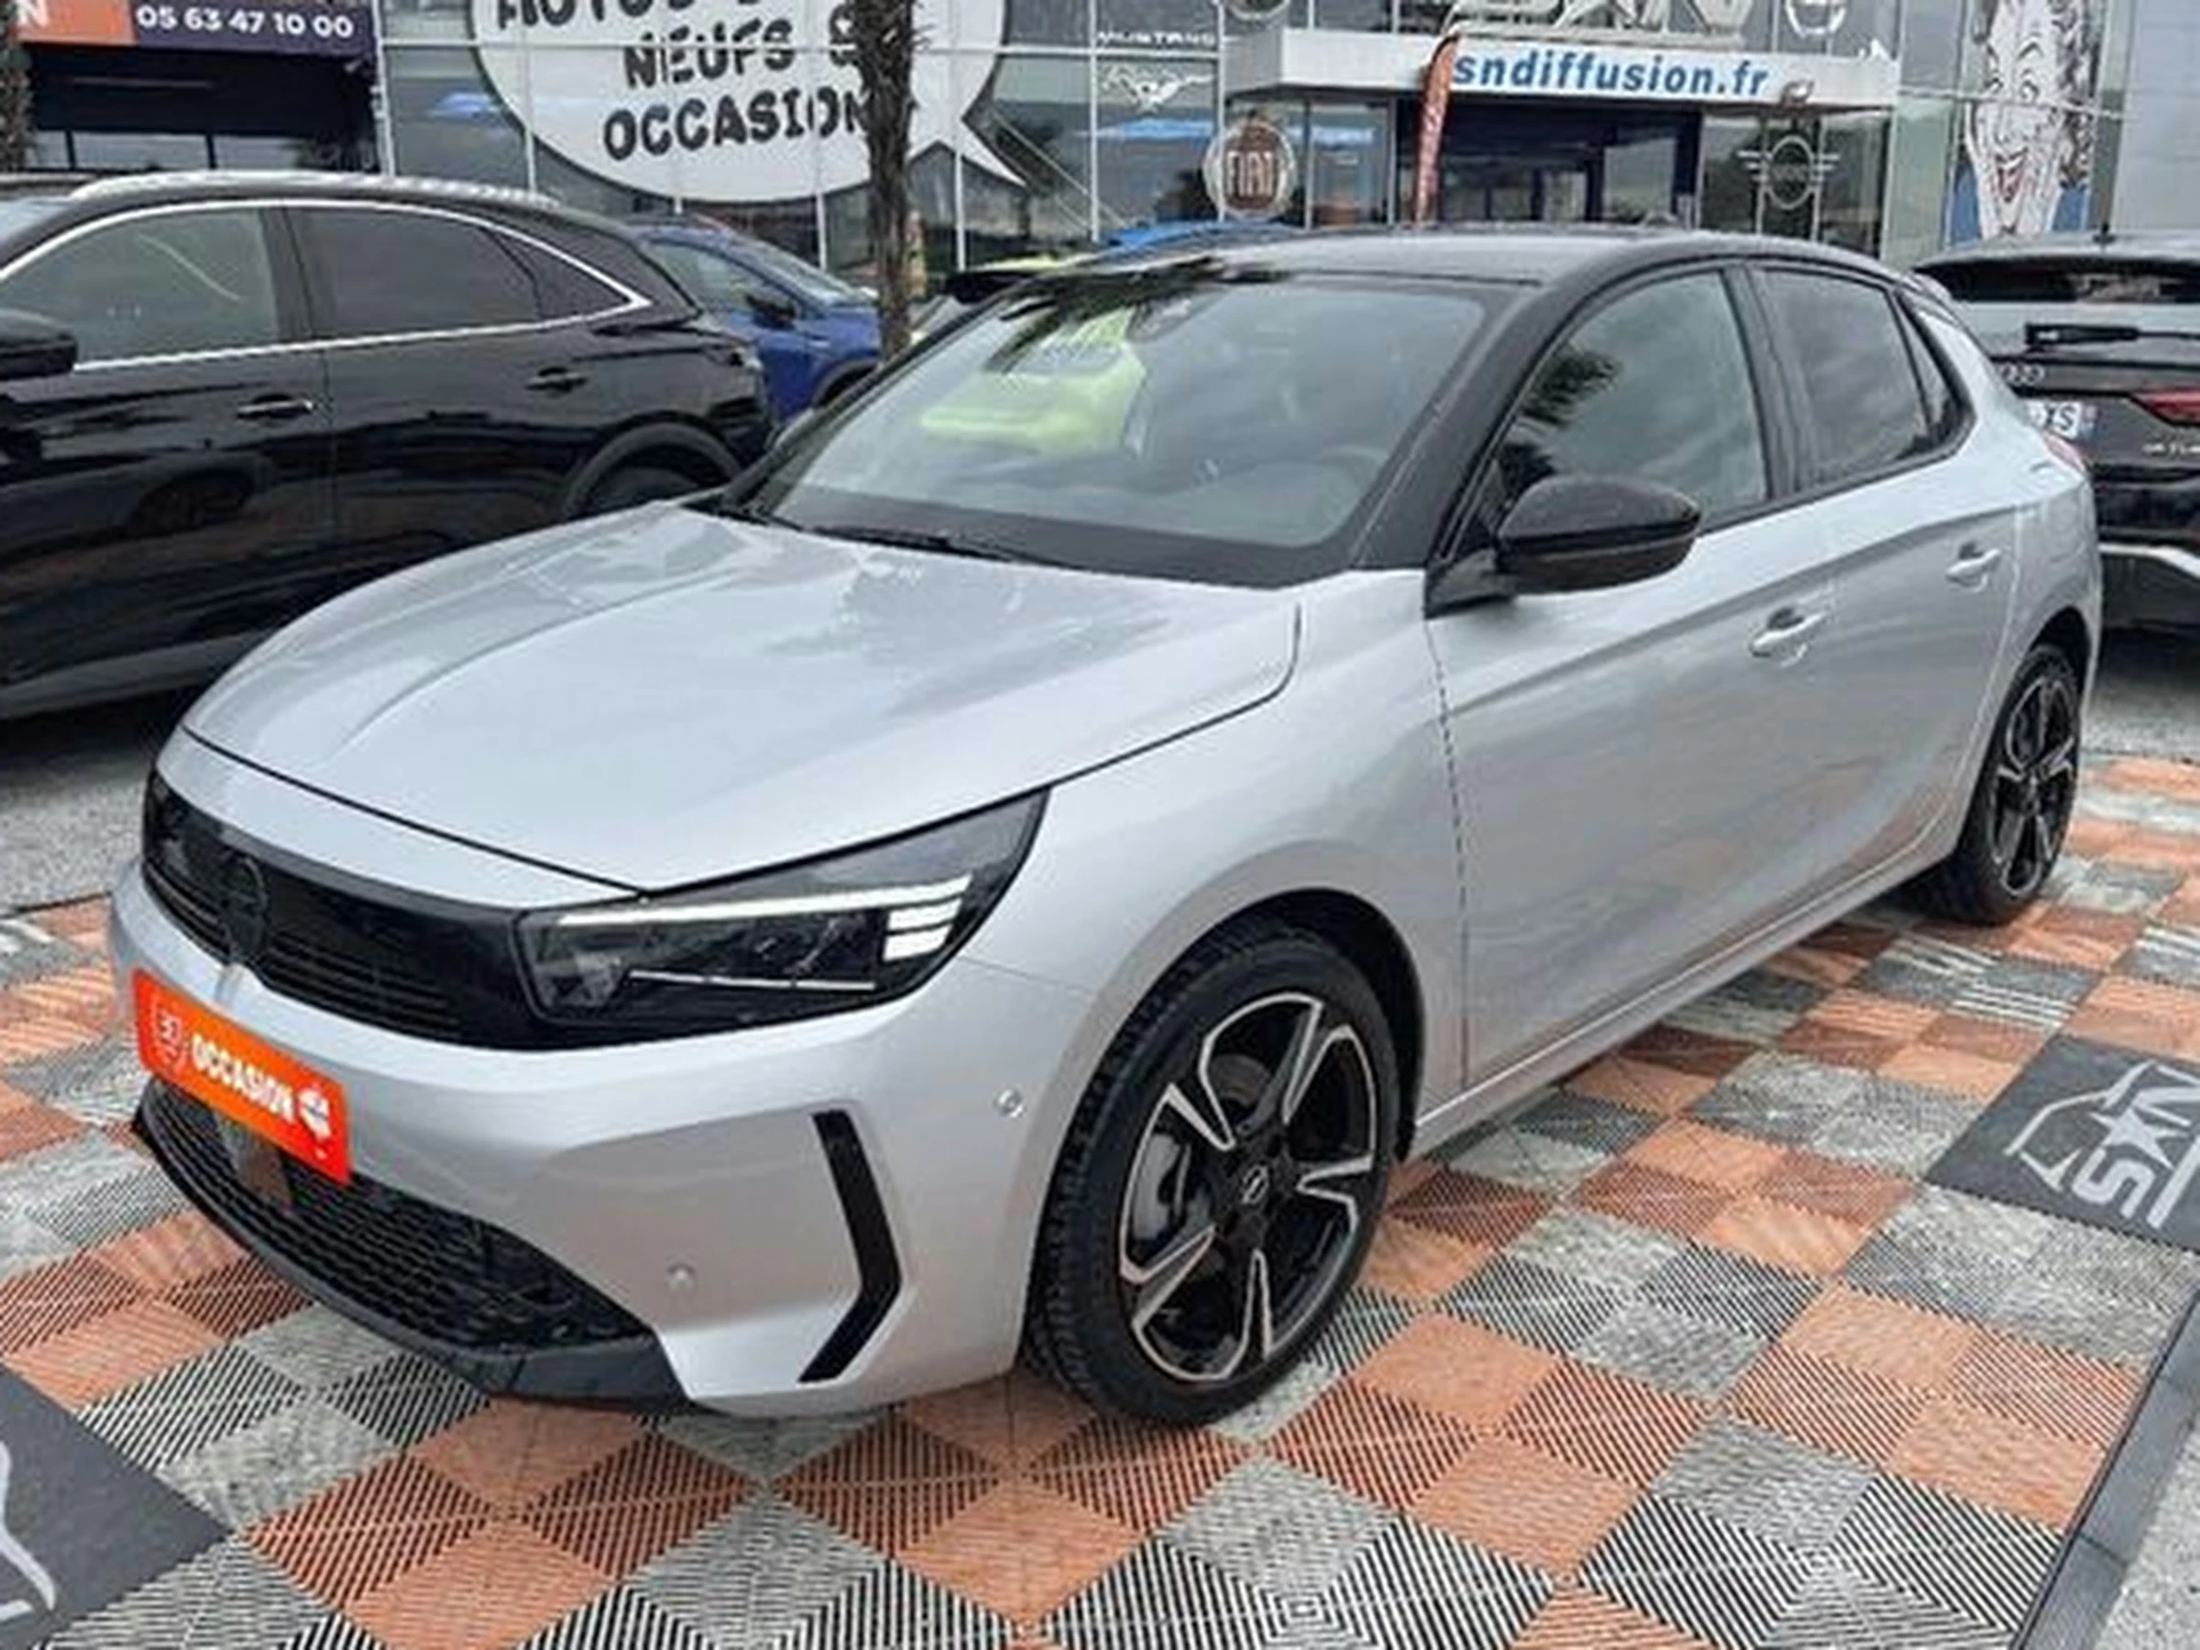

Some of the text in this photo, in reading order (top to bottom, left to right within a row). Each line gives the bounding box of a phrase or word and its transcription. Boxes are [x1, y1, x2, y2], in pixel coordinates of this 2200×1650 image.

[136, 5, 354, 38] 05 63 47 10 00
[624, 18, 795, 89] NEUFS
[1452, 50, 1769, 96] sndiffusion.fr
[1227, 150, 1274, 197] FIAT
